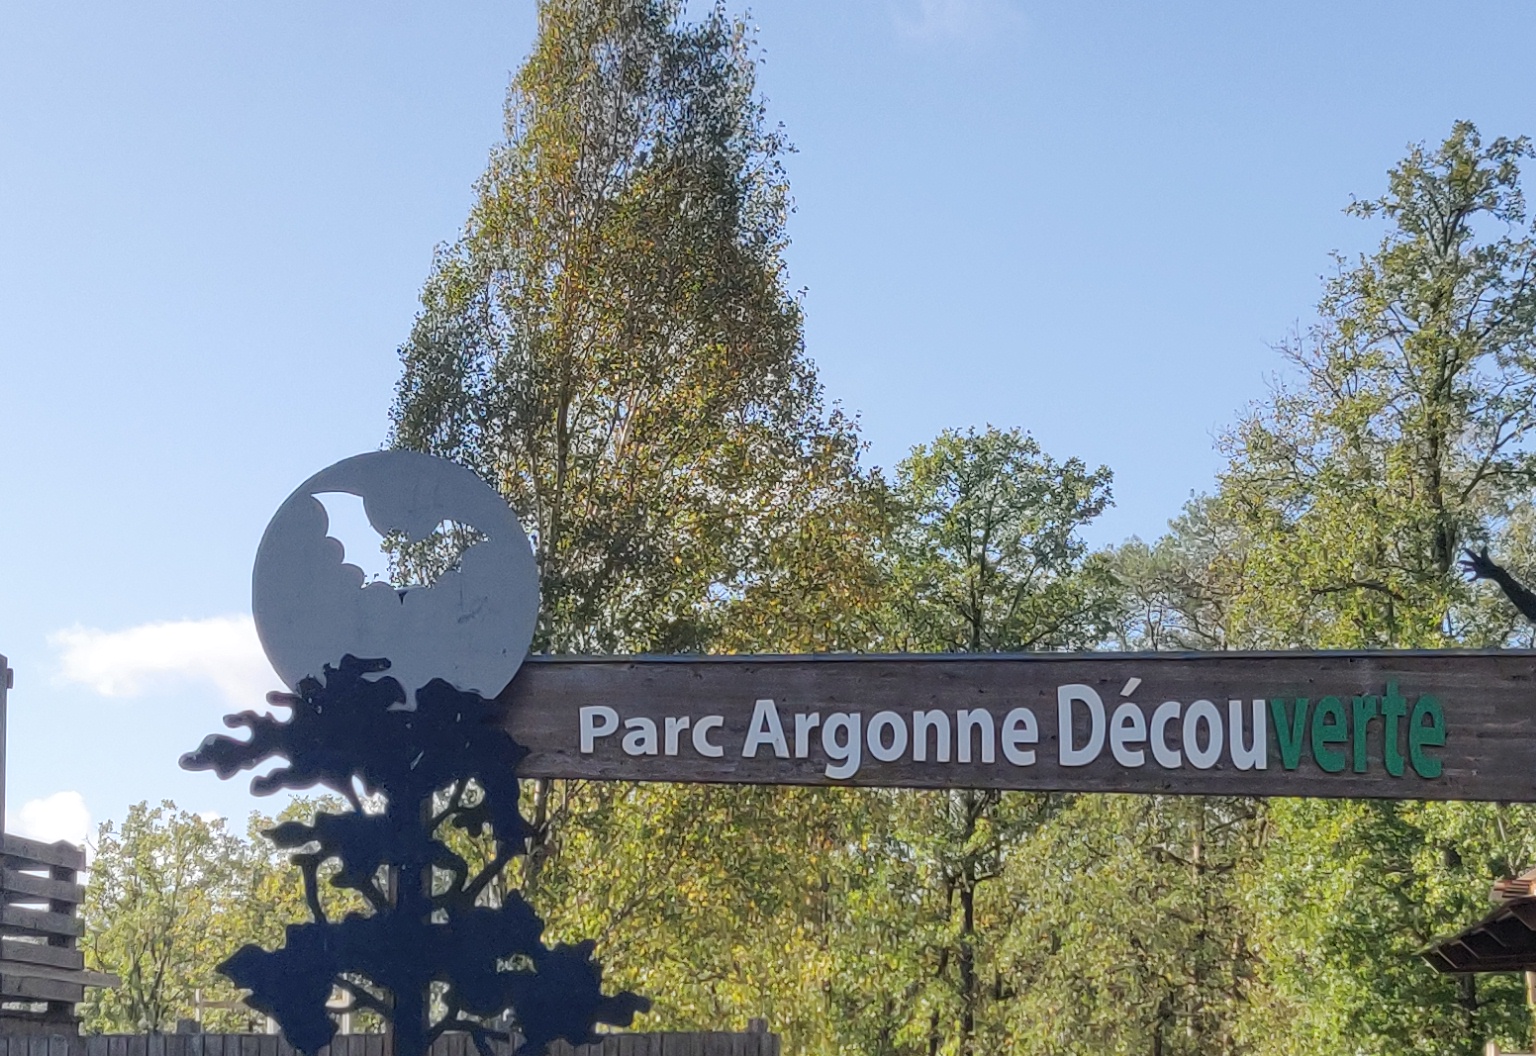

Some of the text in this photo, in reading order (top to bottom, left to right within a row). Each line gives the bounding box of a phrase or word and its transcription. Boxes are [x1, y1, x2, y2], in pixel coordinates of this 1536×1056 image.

[579, 676, 1447, 779] Parc Argonne Découverte
